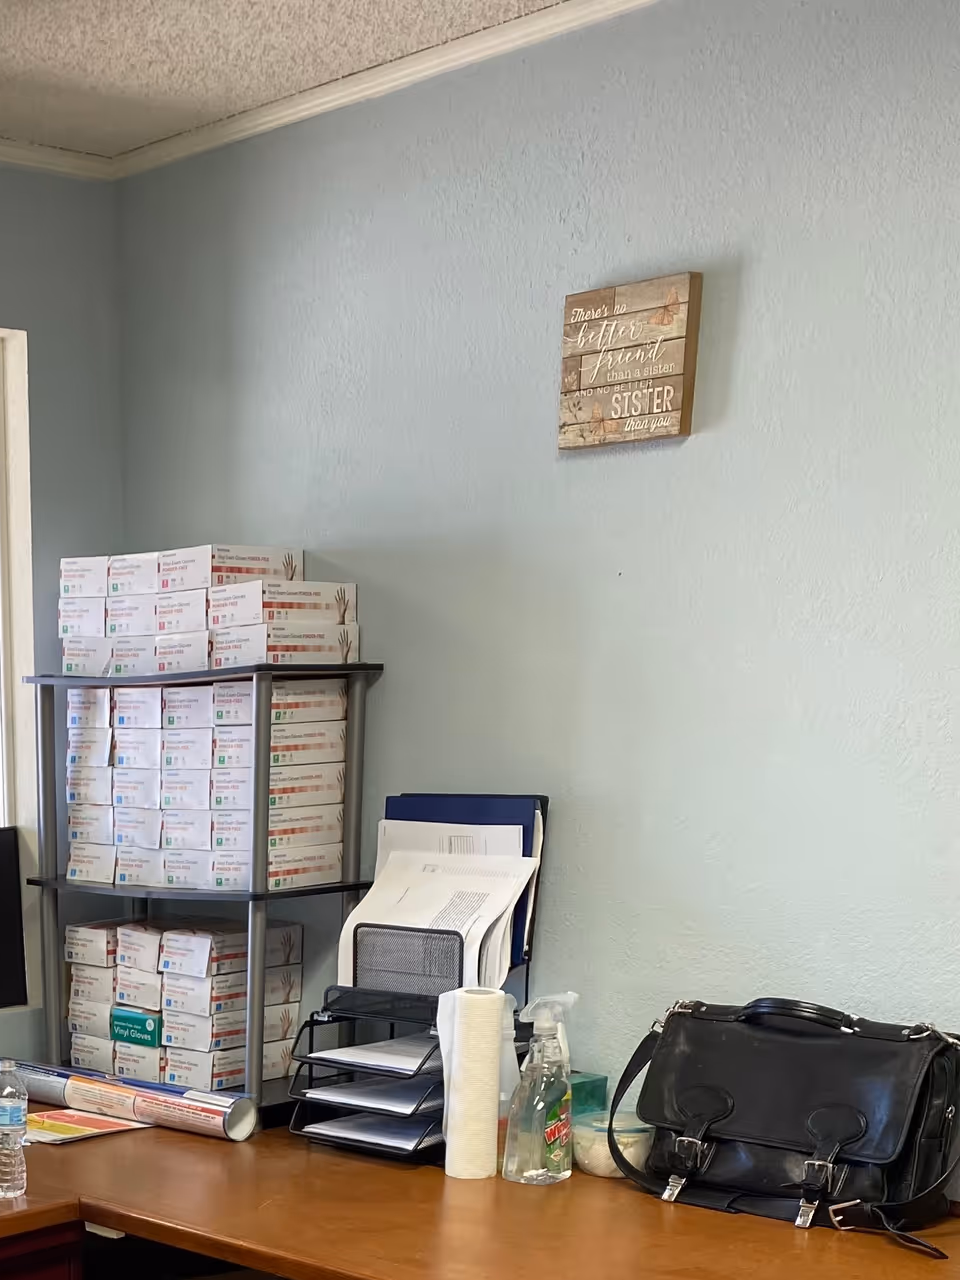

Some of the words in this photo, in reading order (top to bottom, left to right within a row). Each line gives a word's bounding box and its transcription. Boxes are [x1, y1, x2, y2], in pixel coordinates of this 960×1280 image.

[571, 304, 609, 322] There's
[613, 304, 627, 316] no
[565, 319, 645, 350] better
[580, 336, 665, 384] friend
[607, 367, 632, 382] than
[634, 368, 641, 379] a
[644, 362, 675, 376] sister
[574, 388, 594, 398] AND
[596, 386, 611, 394] NO
[614, 379, 653, 393] BETTER
[611, 385, 675, 419] SISTER
[624, 418, 650, 432] than
[650, 416, 672, 433] you
[114, 1026, 129, 1038] Vinyl
[130, 1030, 152, 1040] Gloves
